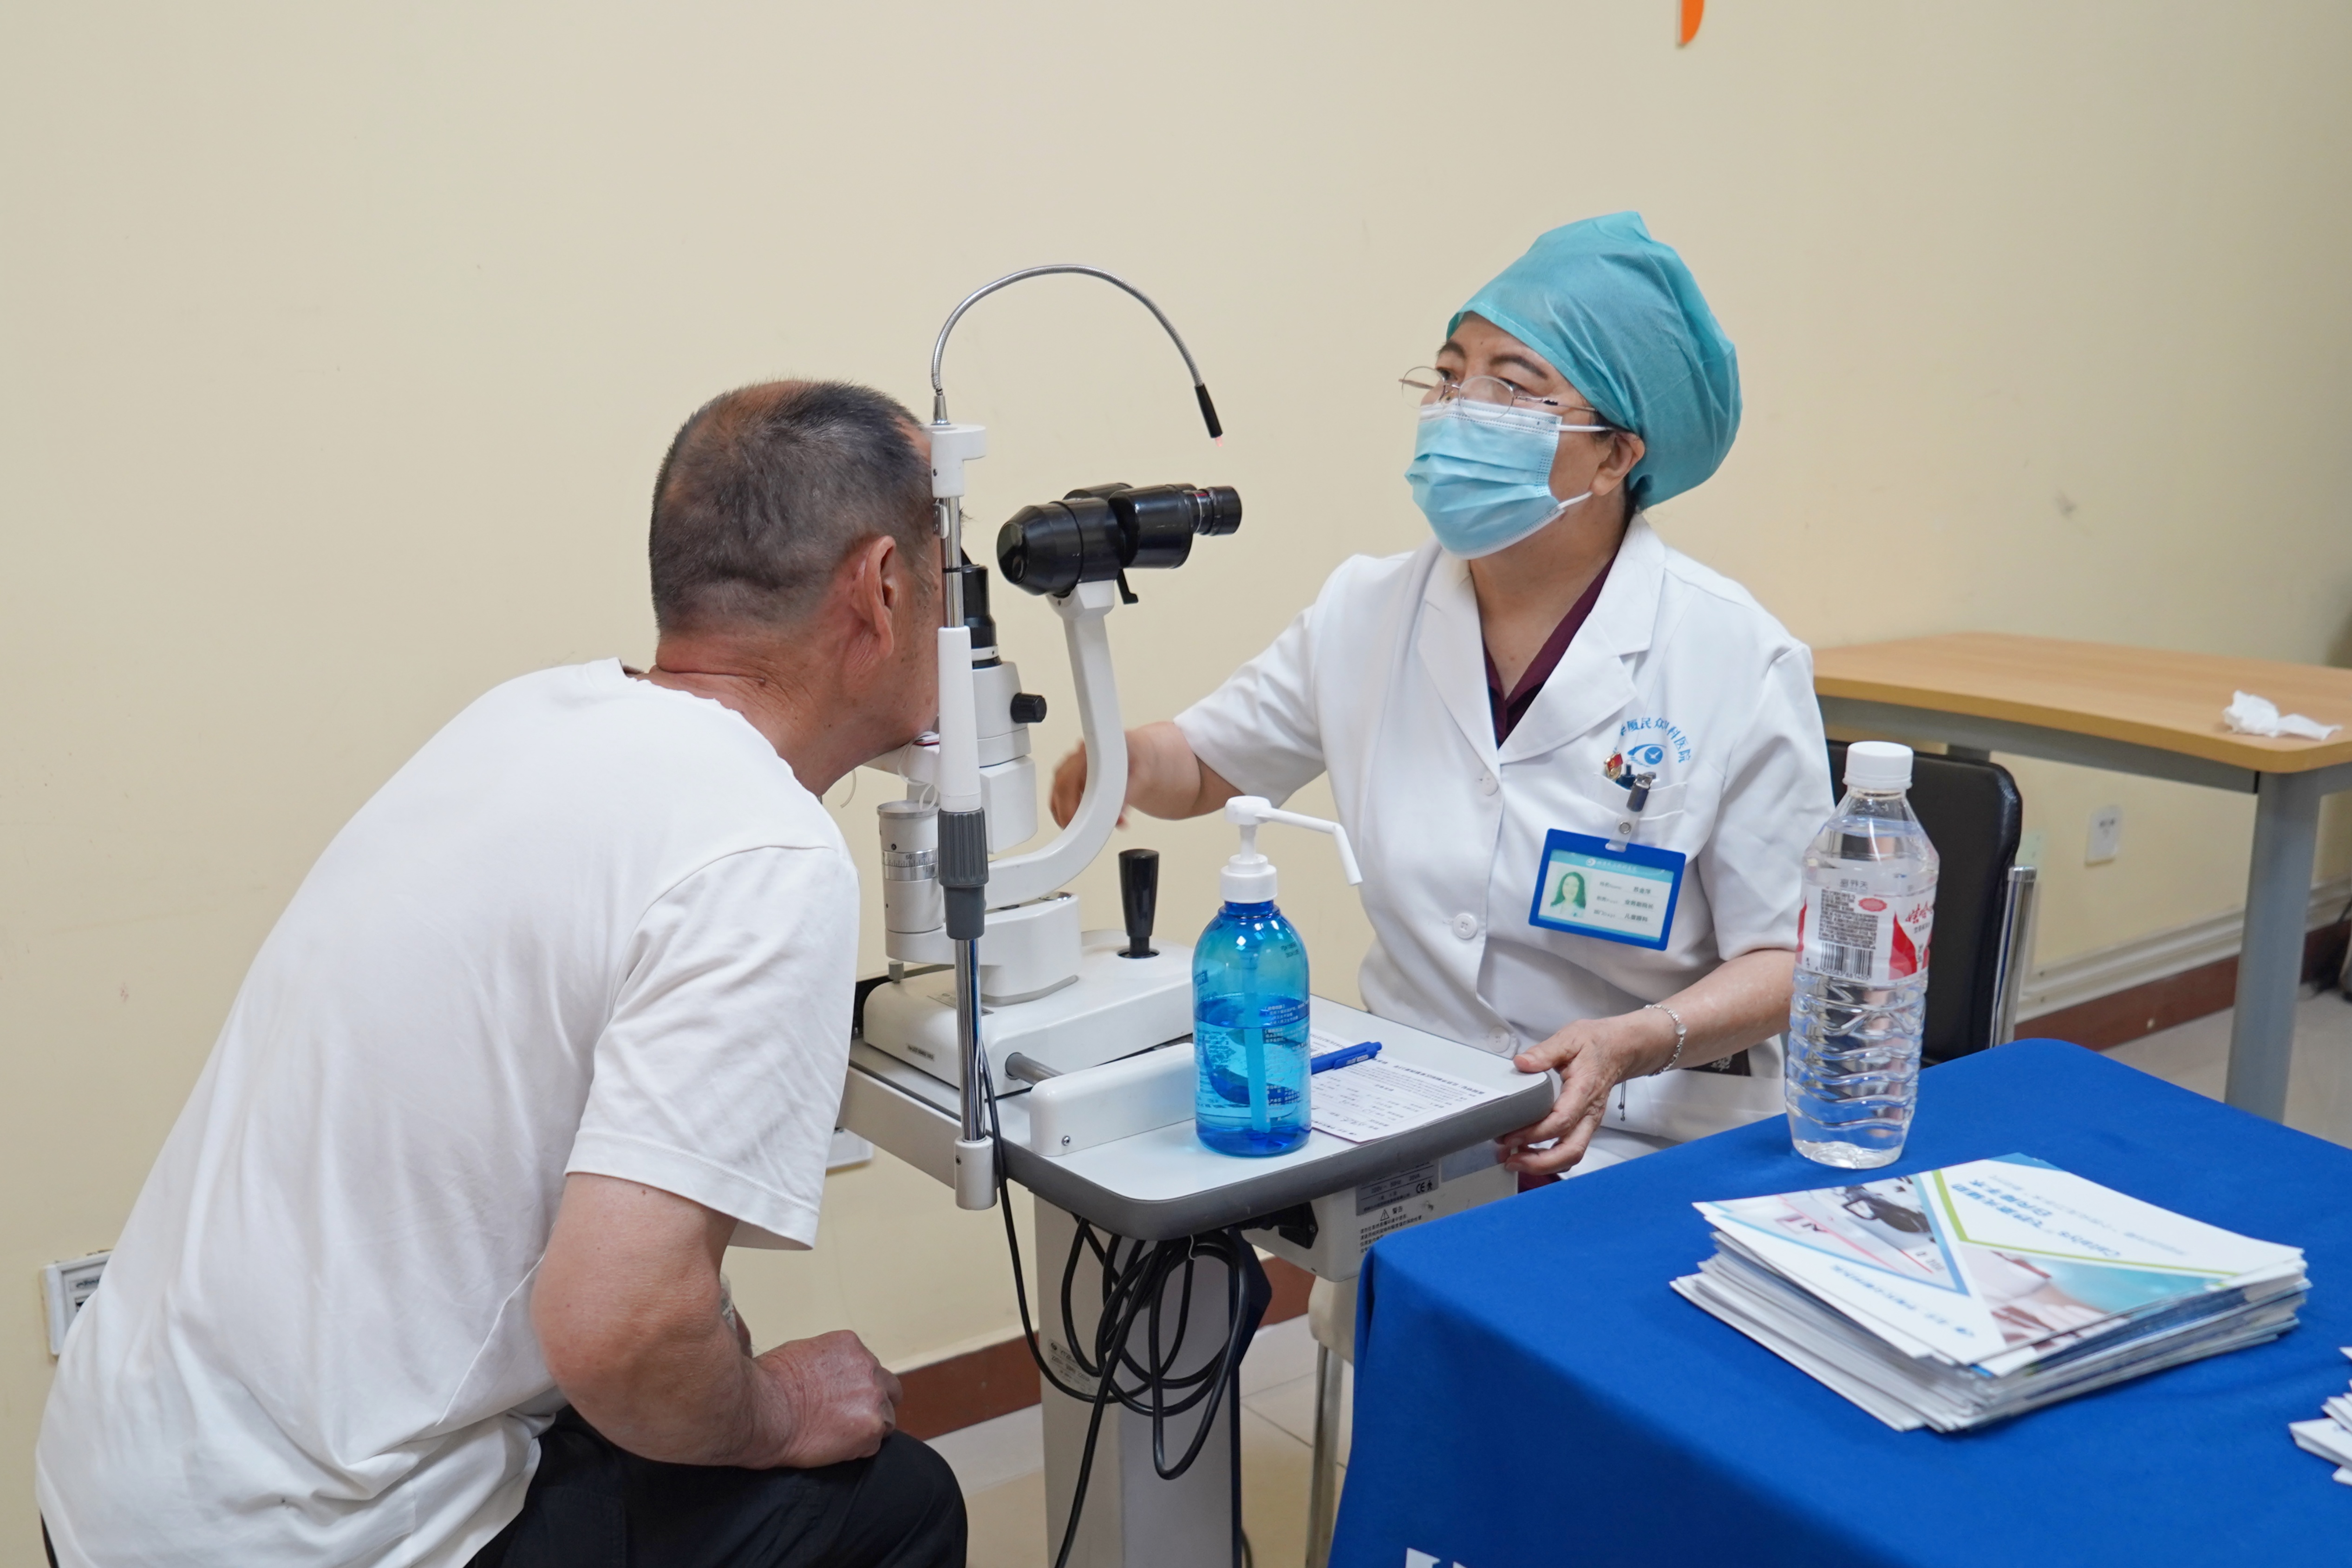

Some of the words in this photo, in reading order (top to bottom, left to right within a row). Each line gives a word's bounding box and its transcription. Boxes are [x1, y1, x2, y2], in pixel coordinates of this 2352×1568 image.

[1624, 913, 1648, 923] 儿童眼科
[1416, 1182, 1425, 1194] CE
[1969, 1179, 2053, 1217] 白内障手术
[1392, 1206, 1403, 1215] 警告
